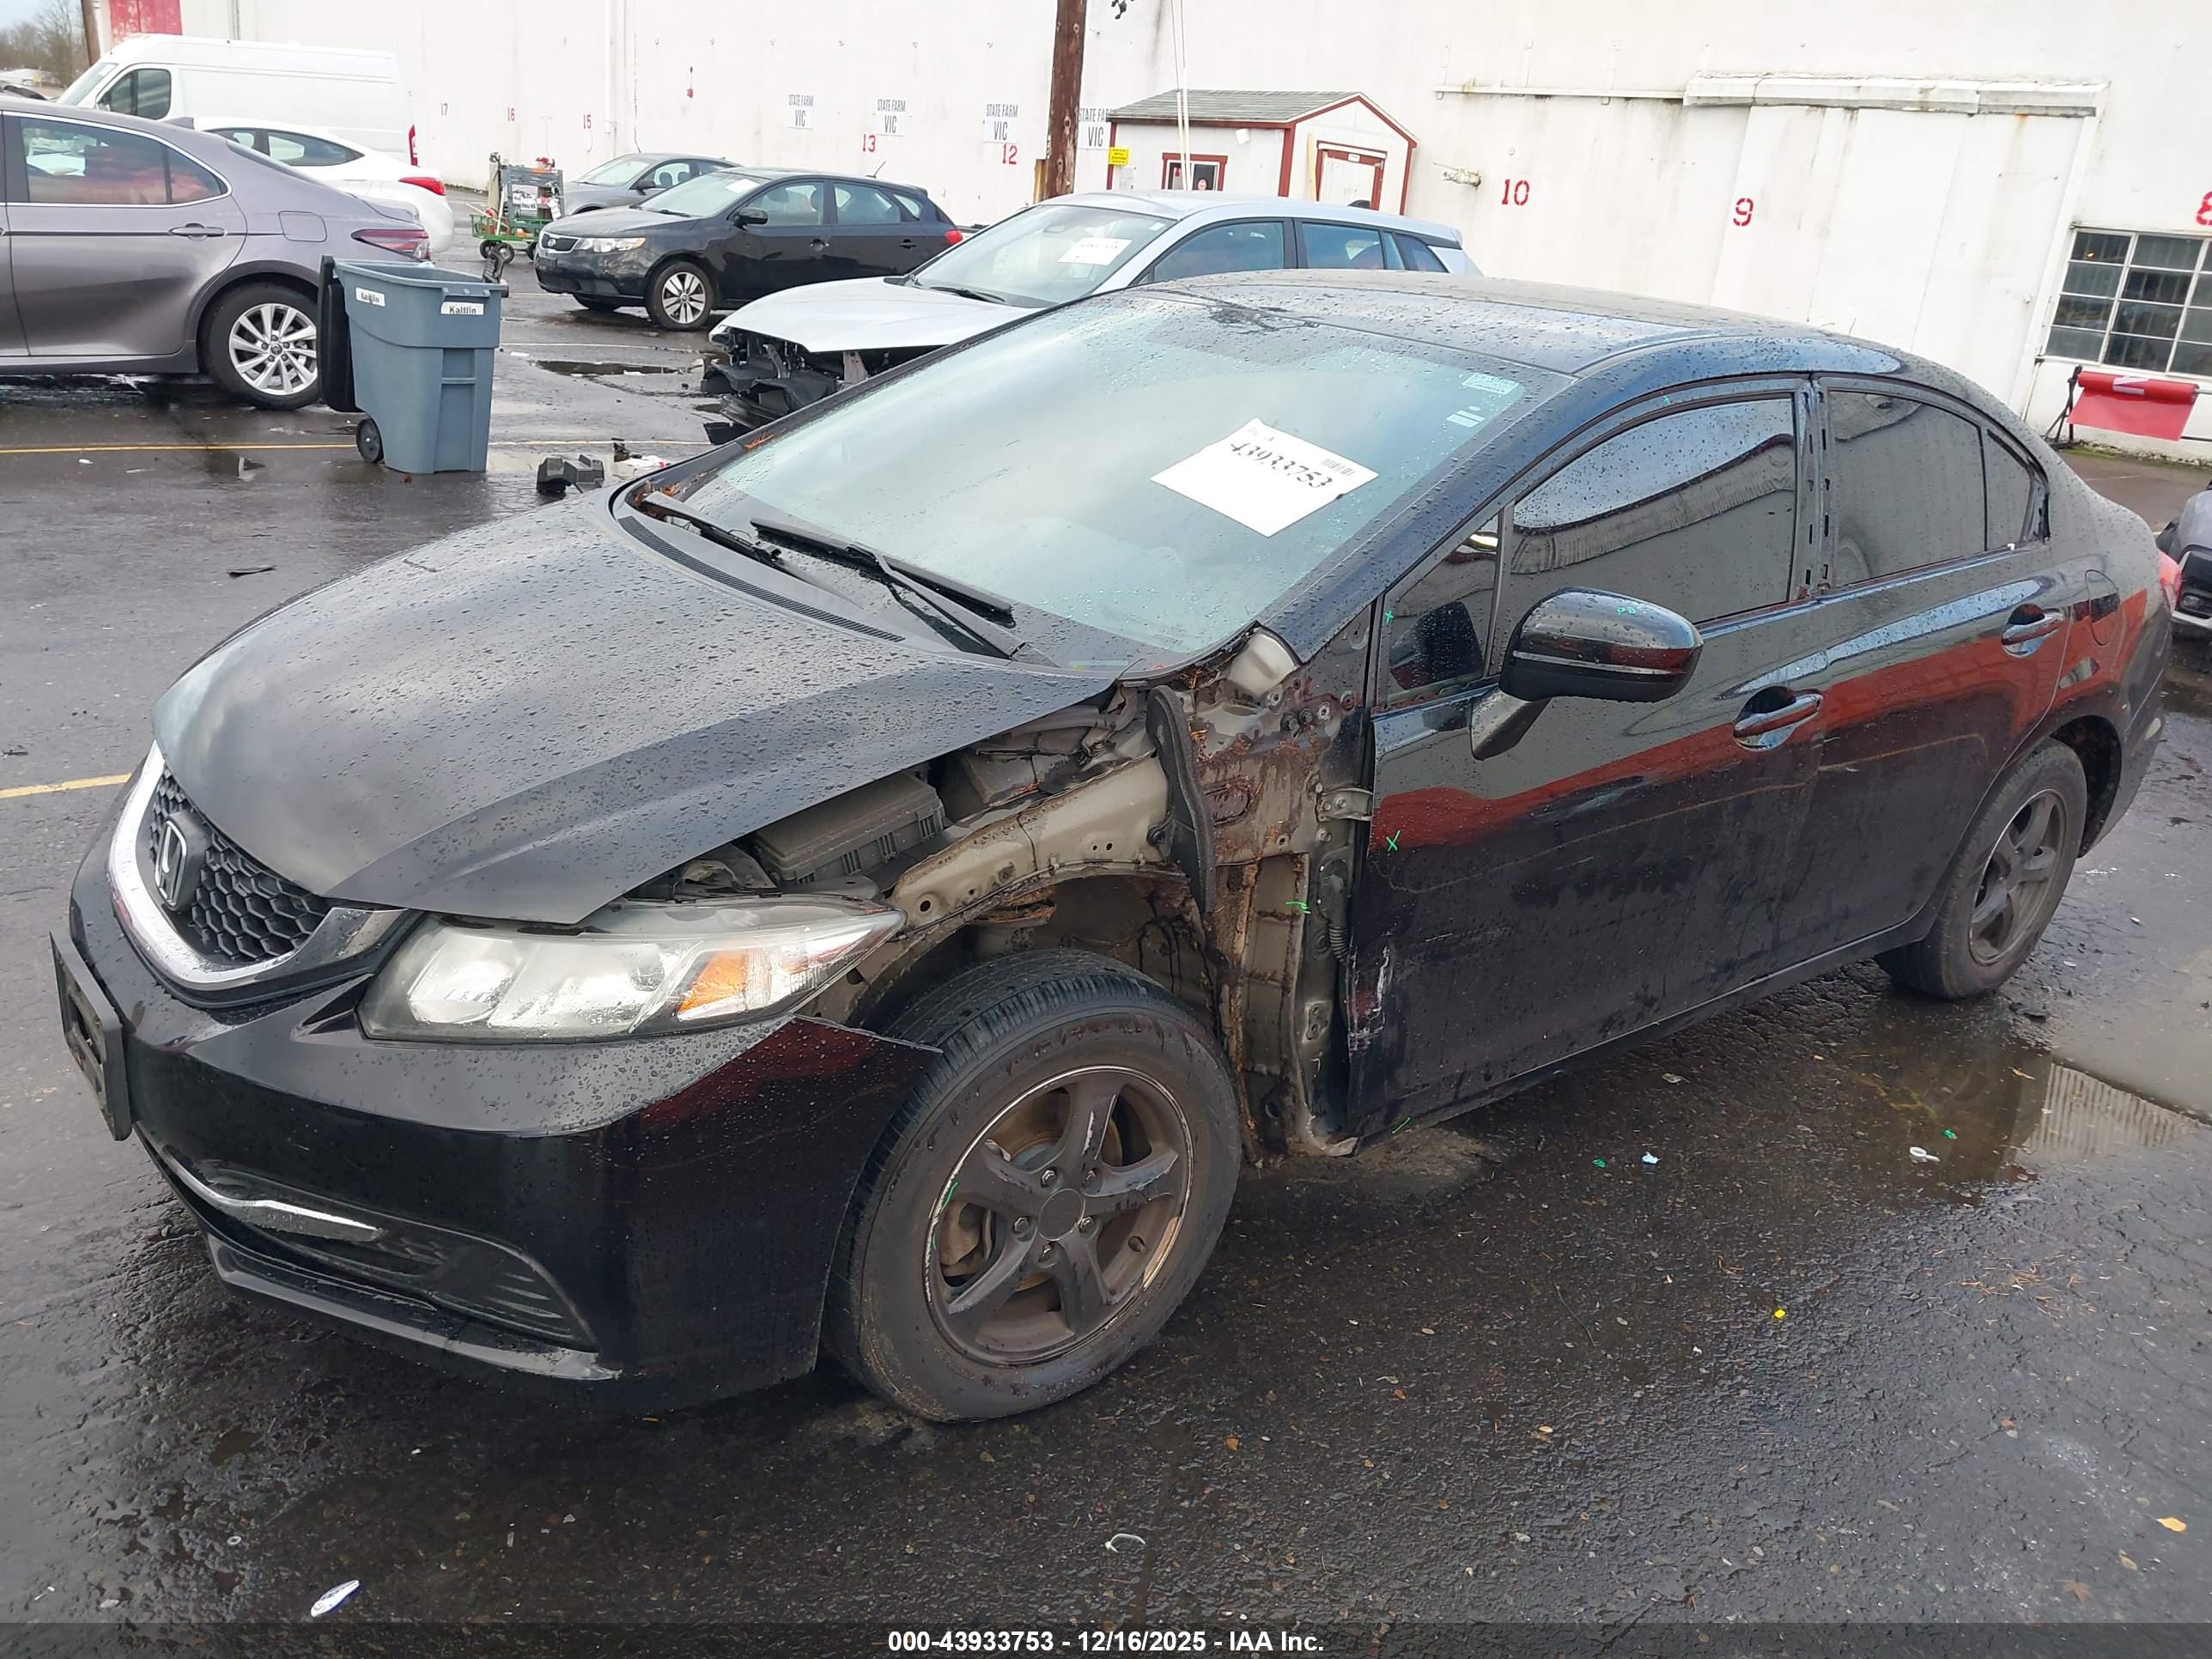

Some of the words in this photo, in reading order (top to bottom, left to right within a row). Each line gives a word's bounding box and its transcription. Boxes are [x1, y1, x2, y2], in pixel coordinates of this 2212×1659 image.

[788, 94, 800, 106] STATE
[800, 95, 814, 106] FARM
[877, 99, 890, 112] STATE
[891, 100, 906, 112] FARM
[507, 107, 515, 122] 16
[794, 109, 806, 128] VIC
[986, 103, 1001, 118] STATE
[1002, 104, 1018, 118] FARM
[1079, 108, 1097, 123] STATE
[582, 114, 592, 130] 15
[884, 115, 897, 134] VIC
[994, 120, 1008, 141] VIC
[862, 133, 876, 152] 13
[1088, 126, 1104, 148] VIC
[1002, 144, 1018, 165] 12
[1501, 179, 1530, 206] 10
[1733, 197, 1755, 227] 9
[449, 305, 477, 315] Kaitlin
[1230, 441, 1334, 489] 43933753
